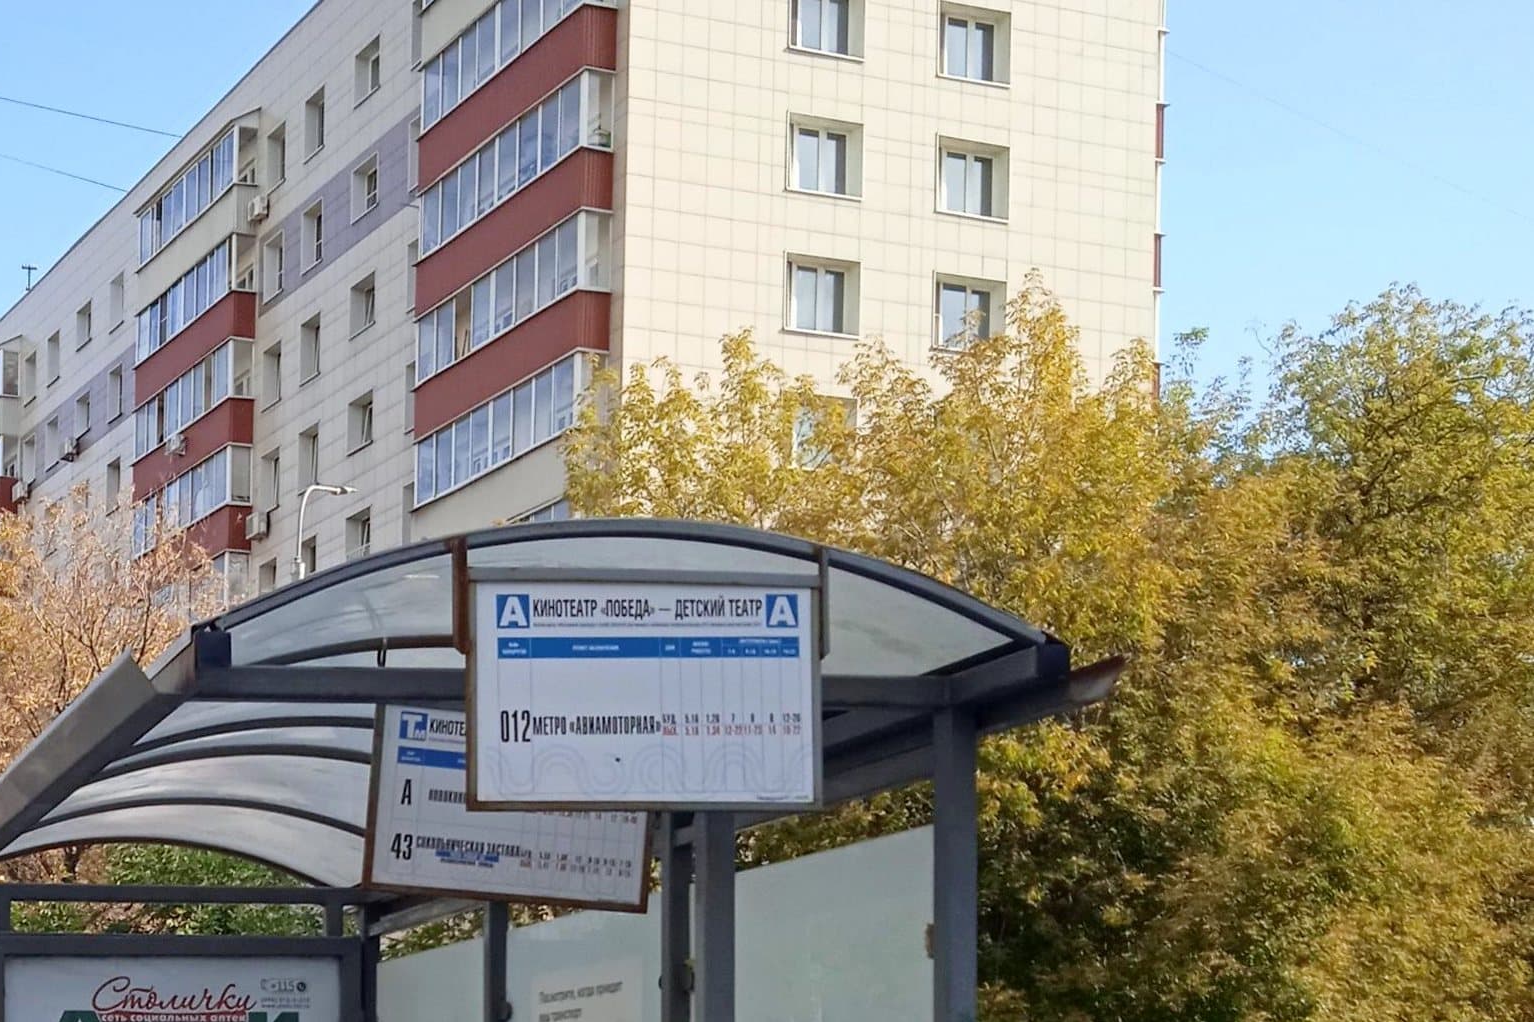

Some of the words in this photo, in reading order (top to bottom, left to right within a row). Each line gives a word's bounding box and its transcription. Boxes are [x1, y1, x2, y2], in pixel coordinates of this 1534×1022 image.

[532, 599, 598, 618] КИНОТЕАТР
[675, 595, 725, 620] ДЕТСКИЙ
[728, 599, 763, 618] ТЕАТР
[429, 718, 466, 737] КИНОТЕ
[500, 709, 531, 743] 012
[532, 715, 567, 735] МЕТРО
[390, 832, 414, 861] 43
[91, 976, 257, 1012] Столички
[101, 1013, 127, 1022] сеть
[130, 1013, 206, 1022] социальных
[210, 1013, 246, 1022] аптек
